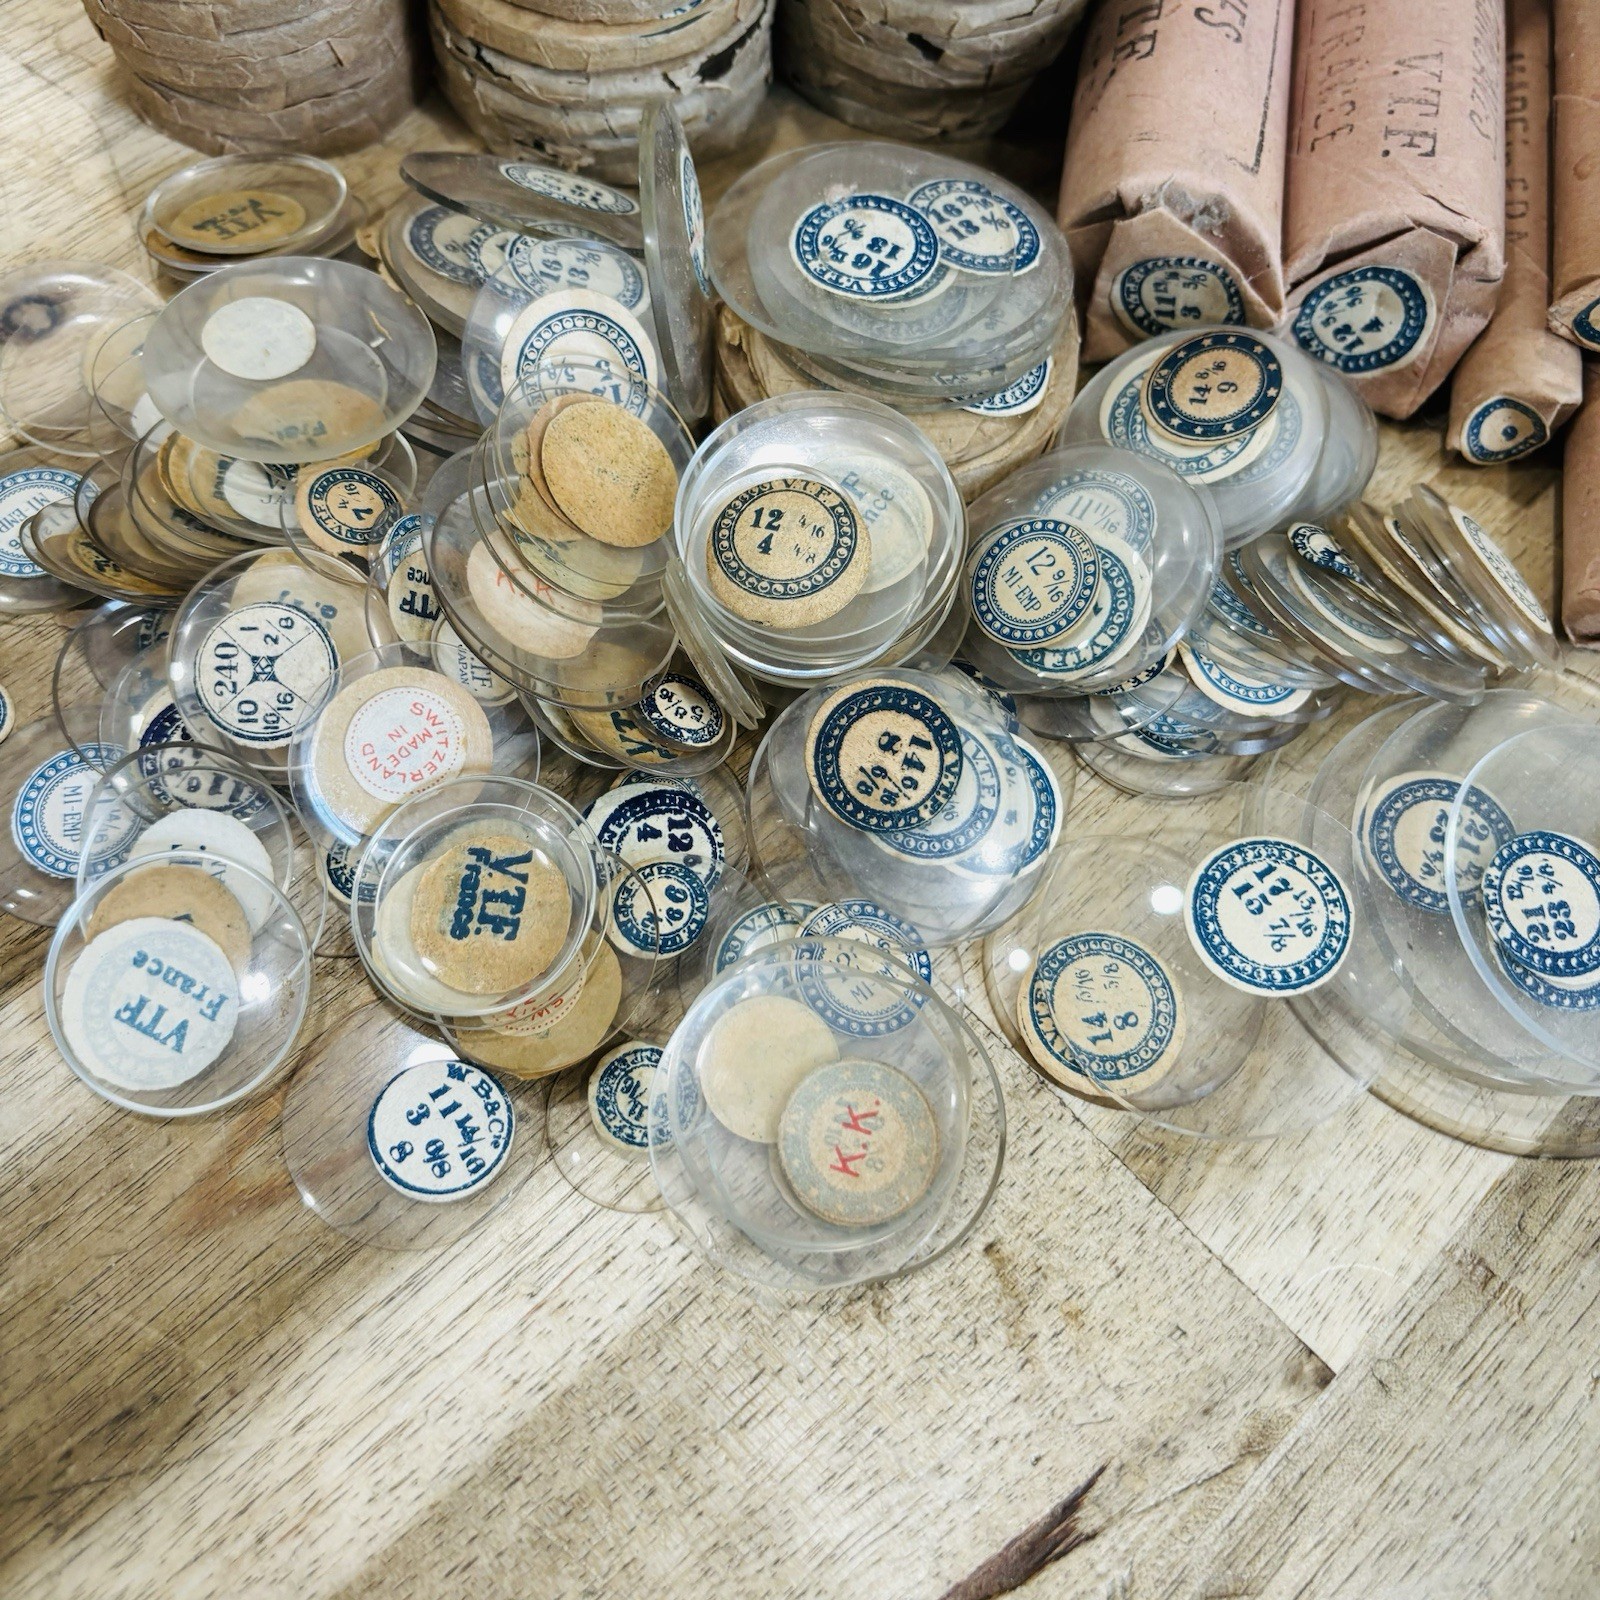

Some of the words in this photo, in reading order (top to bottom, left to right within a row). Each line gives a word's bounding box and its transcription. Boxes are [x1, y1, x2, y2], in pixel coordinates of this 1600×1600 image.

[1217, 381, 1239, 394] 9
[783, 478, 832, 504] V.T.F.
[750, 507, 784, 532] 12
[757, 533, 774, 556] 4
[1025, 545, 1057, 577] 12
[1000, 564, 1043, 614] MI-EMP
[213, 641, 240, 697] 240
[237, 699, 259, 723] 10
[361, 700, 450, 784] SWITZERLAND
[386, 727, 434, 768] MADE
[387, 724, 409, 743] IN
[902, 735, 933, 774] 14
[637, 823, 663, 842] 4
[668, 816, 694, 853] 12
[1306, 859, 1343, 916] V.T.F.
[1522, 904, 1552, 944] 21
[1547, 899, 1578, 940] 23
[131, 949, 230, 1022] France
[1081, 1011, 1114, 1047] 14
[1113, 1011, 1139, 1031] 8
[406, 1102, 431, 1127] 3
[389, 1140, 414, 1163] 8
[829, 1098, 881, 1178] K.K.
